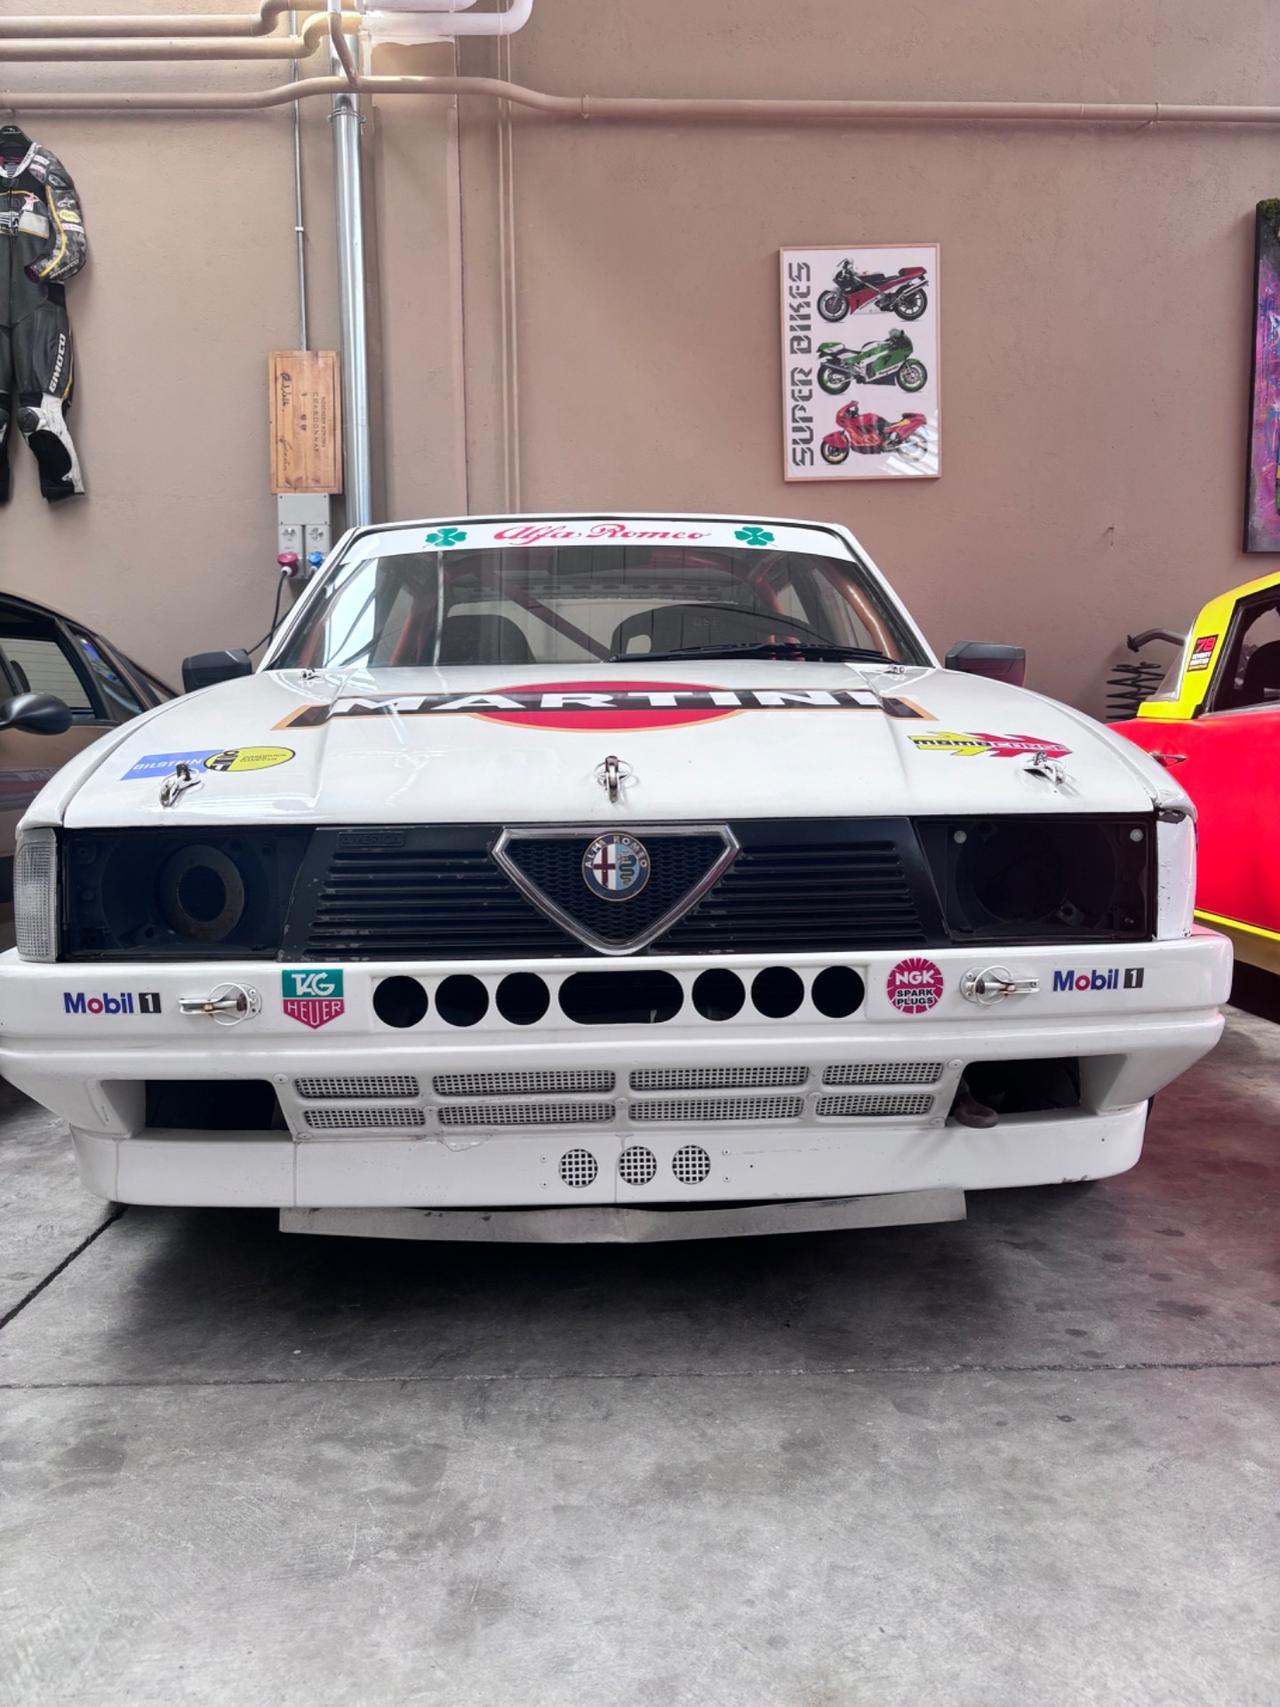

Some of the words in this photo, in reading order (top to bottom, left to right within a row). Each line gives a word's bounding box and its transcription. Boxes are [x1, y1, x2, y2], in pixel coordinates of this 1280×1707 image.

[788, 262, 812, 355] BIKES
[790, 367, 814, 467] SUPER
[493, 525, 582, 546] Alfa
[585, 523, 711, 540] Romeo
[329, 692, 883, 718] MARTINI
[585, 839, 606, 869] ALFA
[613, 835, 648, 868] ROMEO
[291, 972, 335, 997] TAG
[895, 970, 935, 985] NGK
[1053, 968, 1119, 992] Mobil
[63, 991, 134, 1015] Mobil
[142, 992, 159, 1012] 1
[896, 988, 934, 997] SPARK
[896, 997, 934, 1006] PLUGS
[287, 1001, 342, 1026] HEUER
